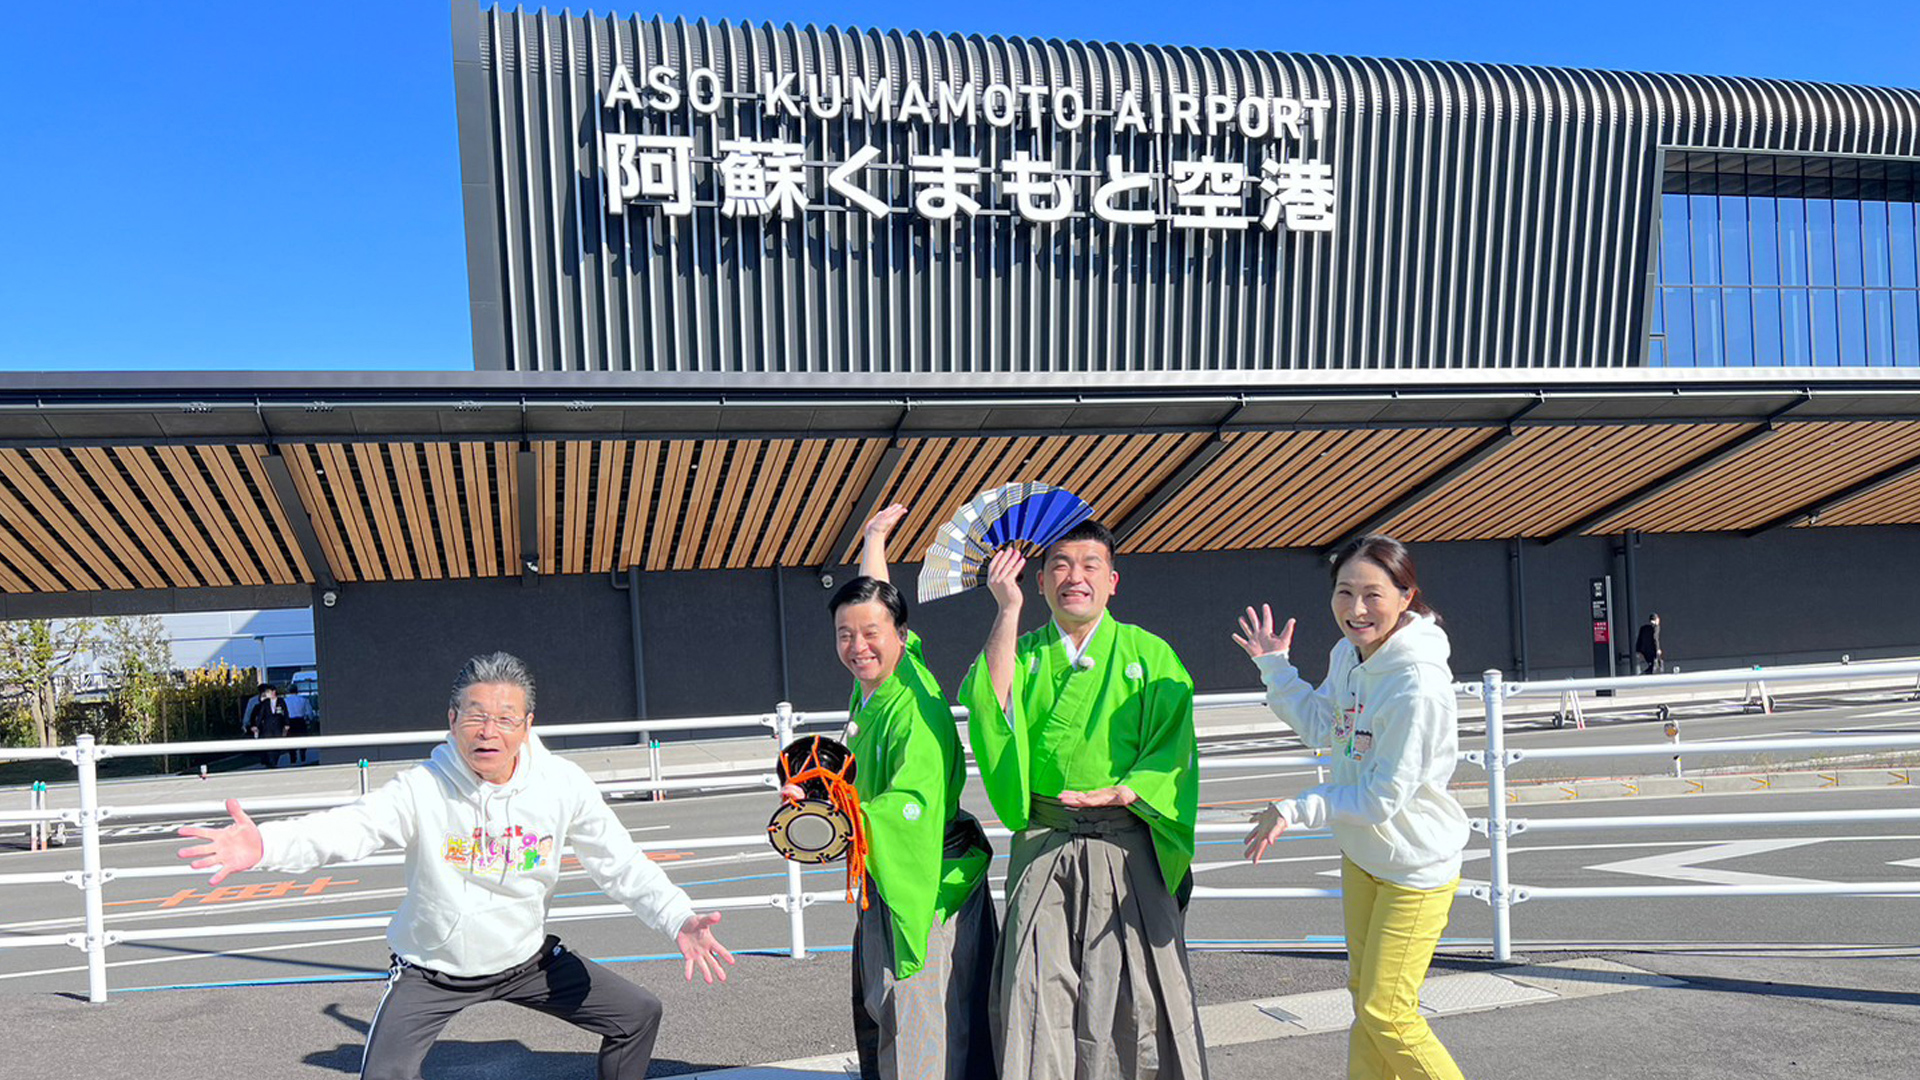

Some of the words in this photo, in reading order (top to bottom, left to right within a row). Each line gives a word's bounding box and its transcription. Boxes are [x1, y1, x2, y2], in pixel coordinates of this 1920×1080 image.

[603, 65, 722, 113] ASO
[764, 72, 1085, 131] KUMAMOTO
[1114, 91, 1332, 140] AIRPORT
[604, 132, 1335, 232] 阿蘇くまもと空港
